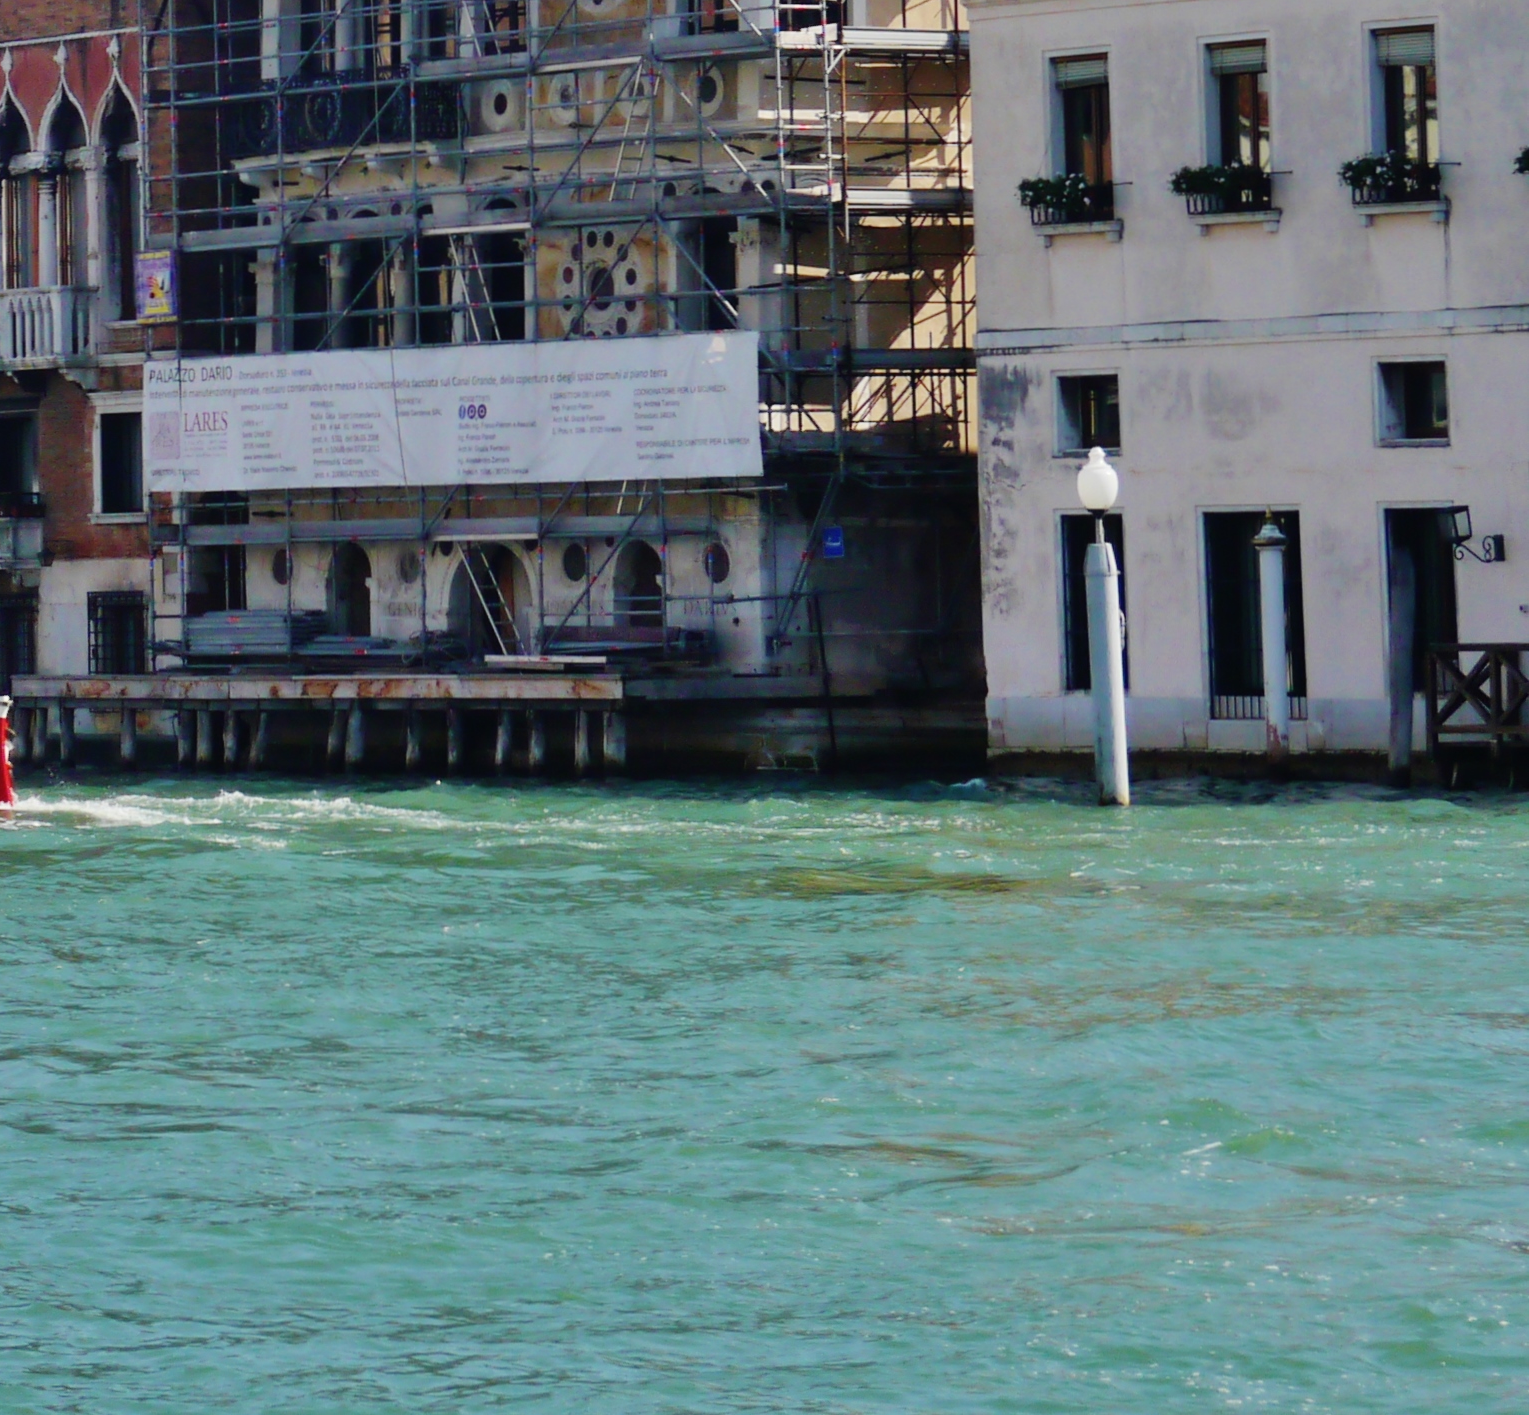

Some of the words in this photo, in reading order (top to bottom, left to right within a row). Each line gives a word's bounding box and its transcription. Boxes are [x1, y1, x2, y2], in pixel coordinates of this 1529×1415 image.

[149, 367, 195, 383] PALAZZO
[201, 365, 233, 382] DARIO
[184, 411, 228, 433] LARES
